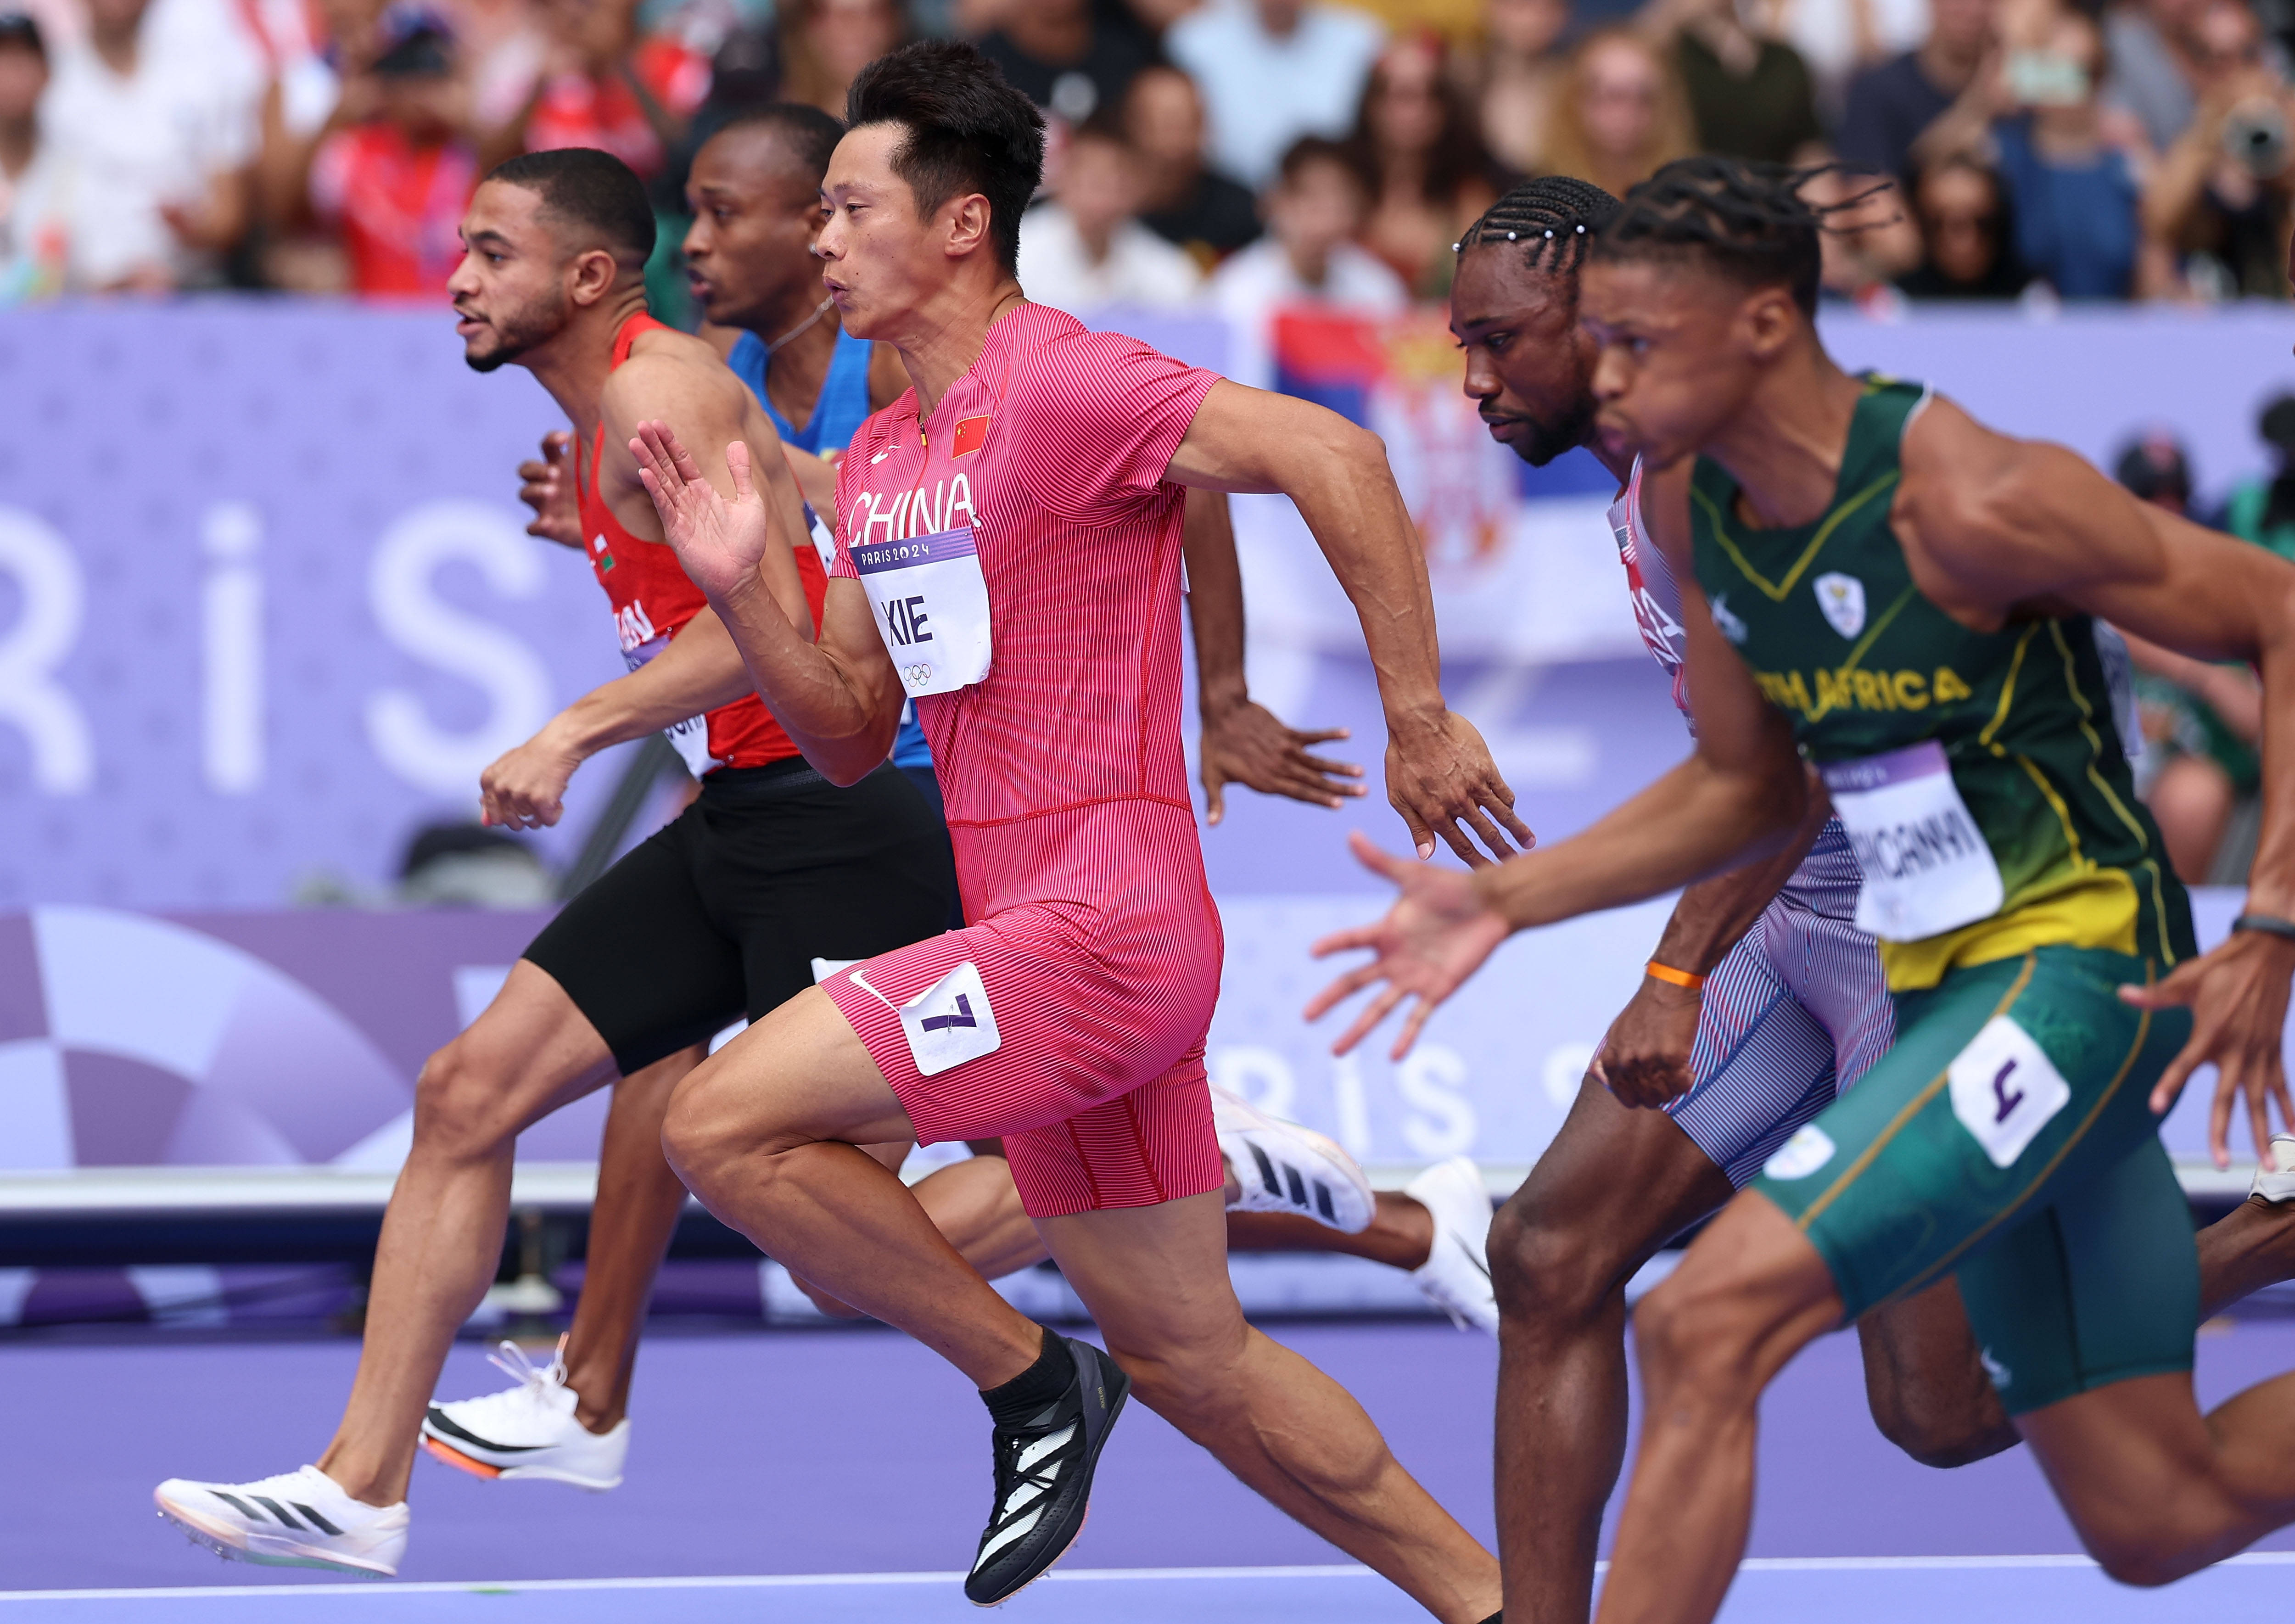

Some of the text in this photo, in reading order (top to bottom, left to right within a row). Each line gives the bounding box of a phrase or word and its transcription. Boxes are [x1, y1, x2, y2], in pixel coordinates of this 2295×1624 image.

[847, 473, 974, 547] CHINA
[892, 543, 929, 561] 2024
[881, 595, 933, 647] XIE
[921, 993, 977, 1032] 7
